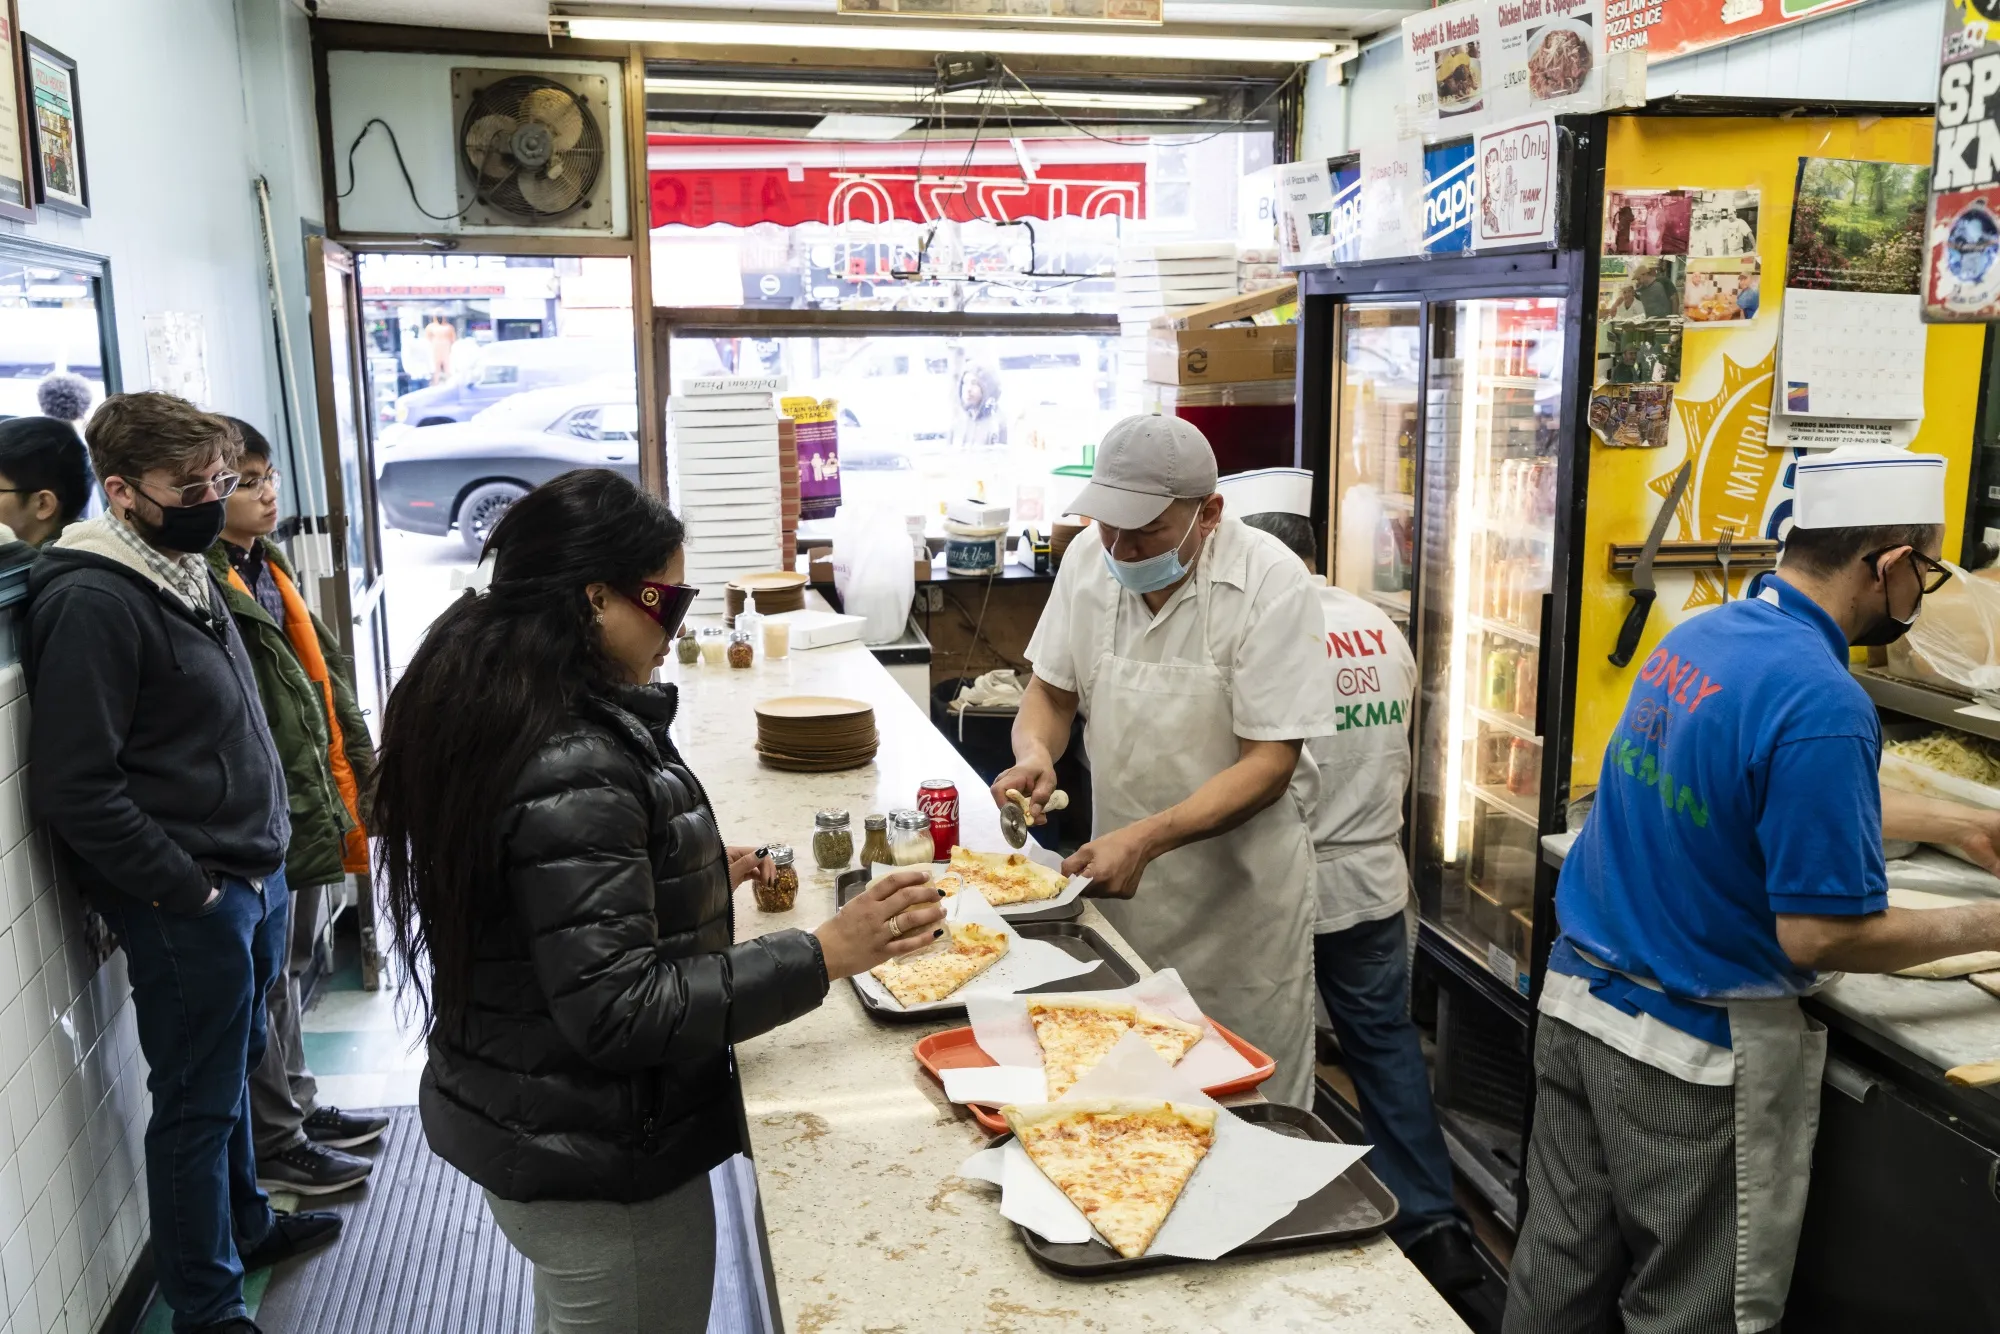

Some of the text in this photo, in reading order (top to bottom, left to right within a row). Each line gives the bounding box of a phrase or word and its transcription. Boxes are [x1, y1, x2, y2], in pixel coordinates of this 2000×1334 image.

[1498, 2, 1521, 27] Chicken
[1604, 5, 1663, 36] PIZZA SLICE
[1411, 13, 1480, 56] Spaghetti & Meatballs
[1499, 133, 1548, 164] Cash Only
[1519, 187, 1542, 204] THANK
[1523, 206, 1536, 221] YOU
[694, 379, 778, 391] Delicious Pizza
[1818, 422, 1870, 430] HAMBURGER
[971, 546, 992, 566] You
[1336, 666, 1381, 697] ON
[1641, 647, 1723, 713] ONLY
[1630, 697, 1673, 748] ON
